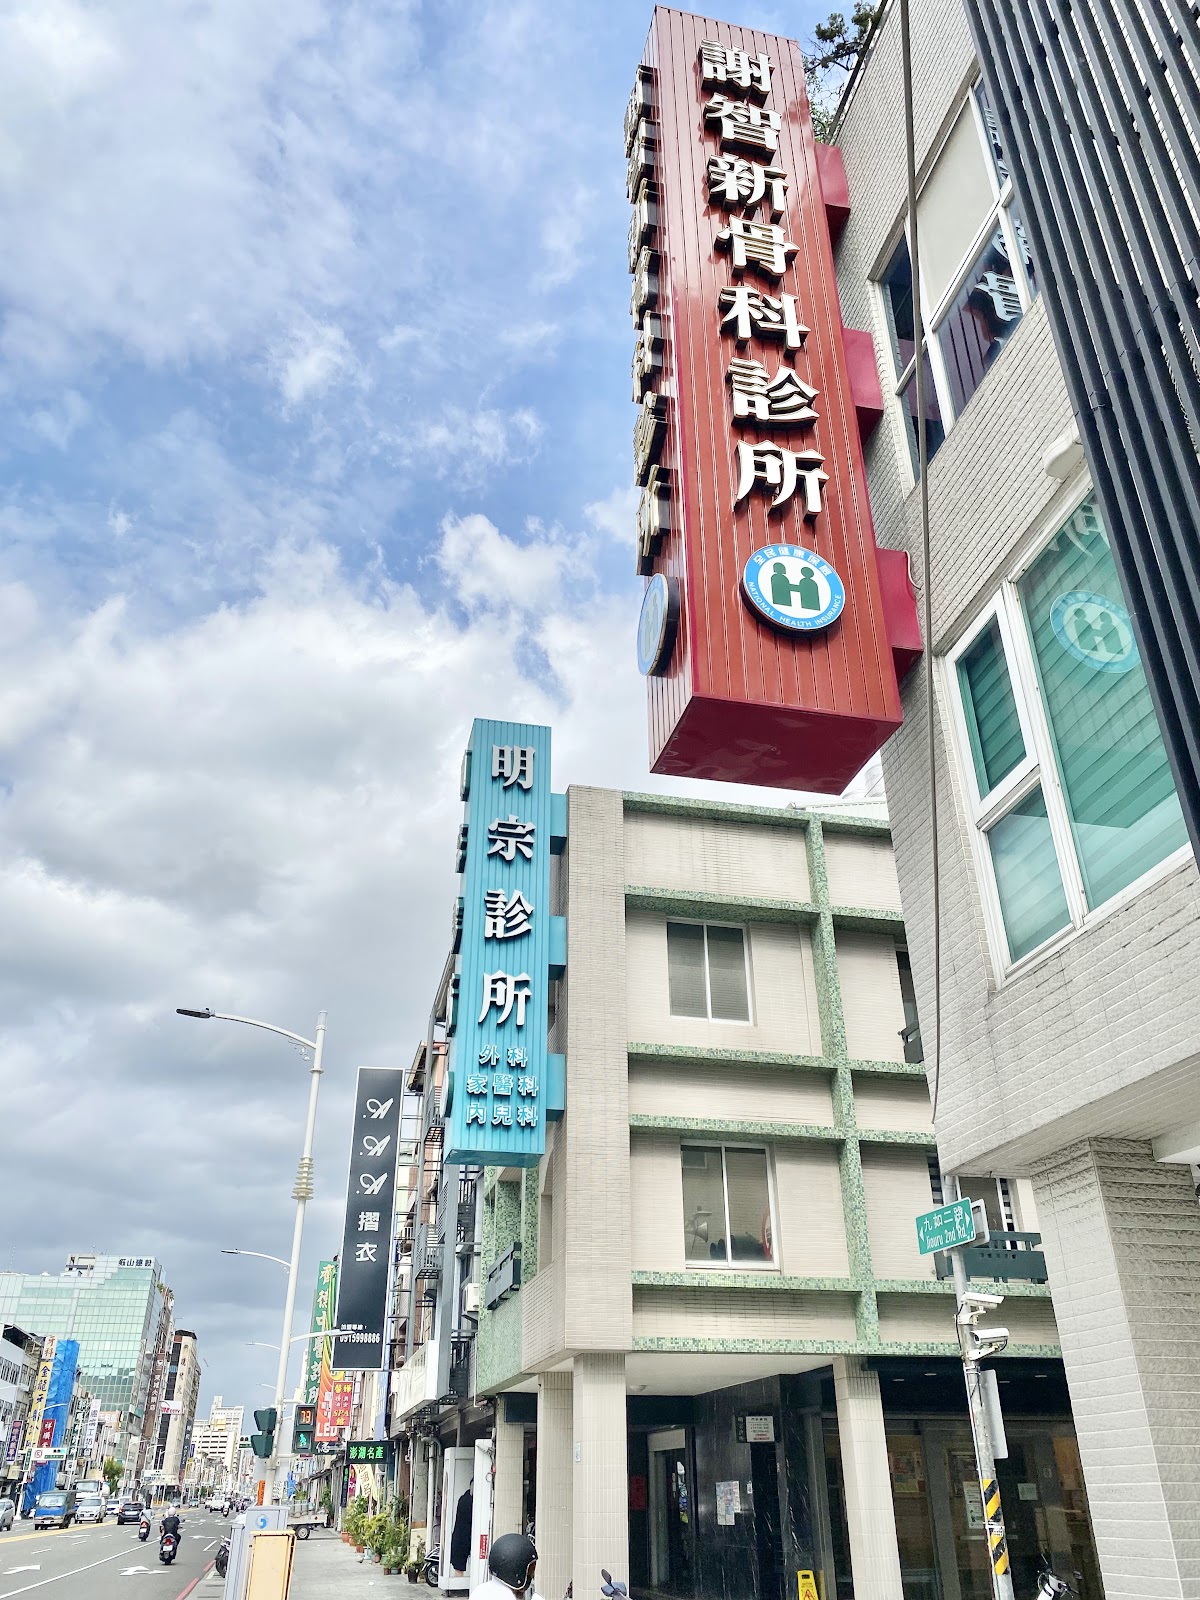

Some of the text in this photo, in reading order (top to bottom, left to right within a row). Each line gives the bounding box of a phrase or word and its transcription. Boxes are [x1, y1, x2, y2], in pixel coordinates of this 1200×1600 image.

[700, 40, 830, 515] 謝智新骨科診所
[748, 581, 842, 627] NATIONAL HEALTH INSURANCE
[478, 745, 536, 1026] 明宗診所
[478, 1045, 528, 1067] 外科
[466, 1074, 539, 1097] 家醫科
[923, 1205, 963, 1232] 九如二路
[355, 1212, 380, 1262] 摺衣
[944, 1227, 956, 1243] 2nd
[44, 1334, 56, 1357] 牙科
[317, 1422, 338, 1437] LED
[349, 1446, 384, 1459] 澎湖名產
